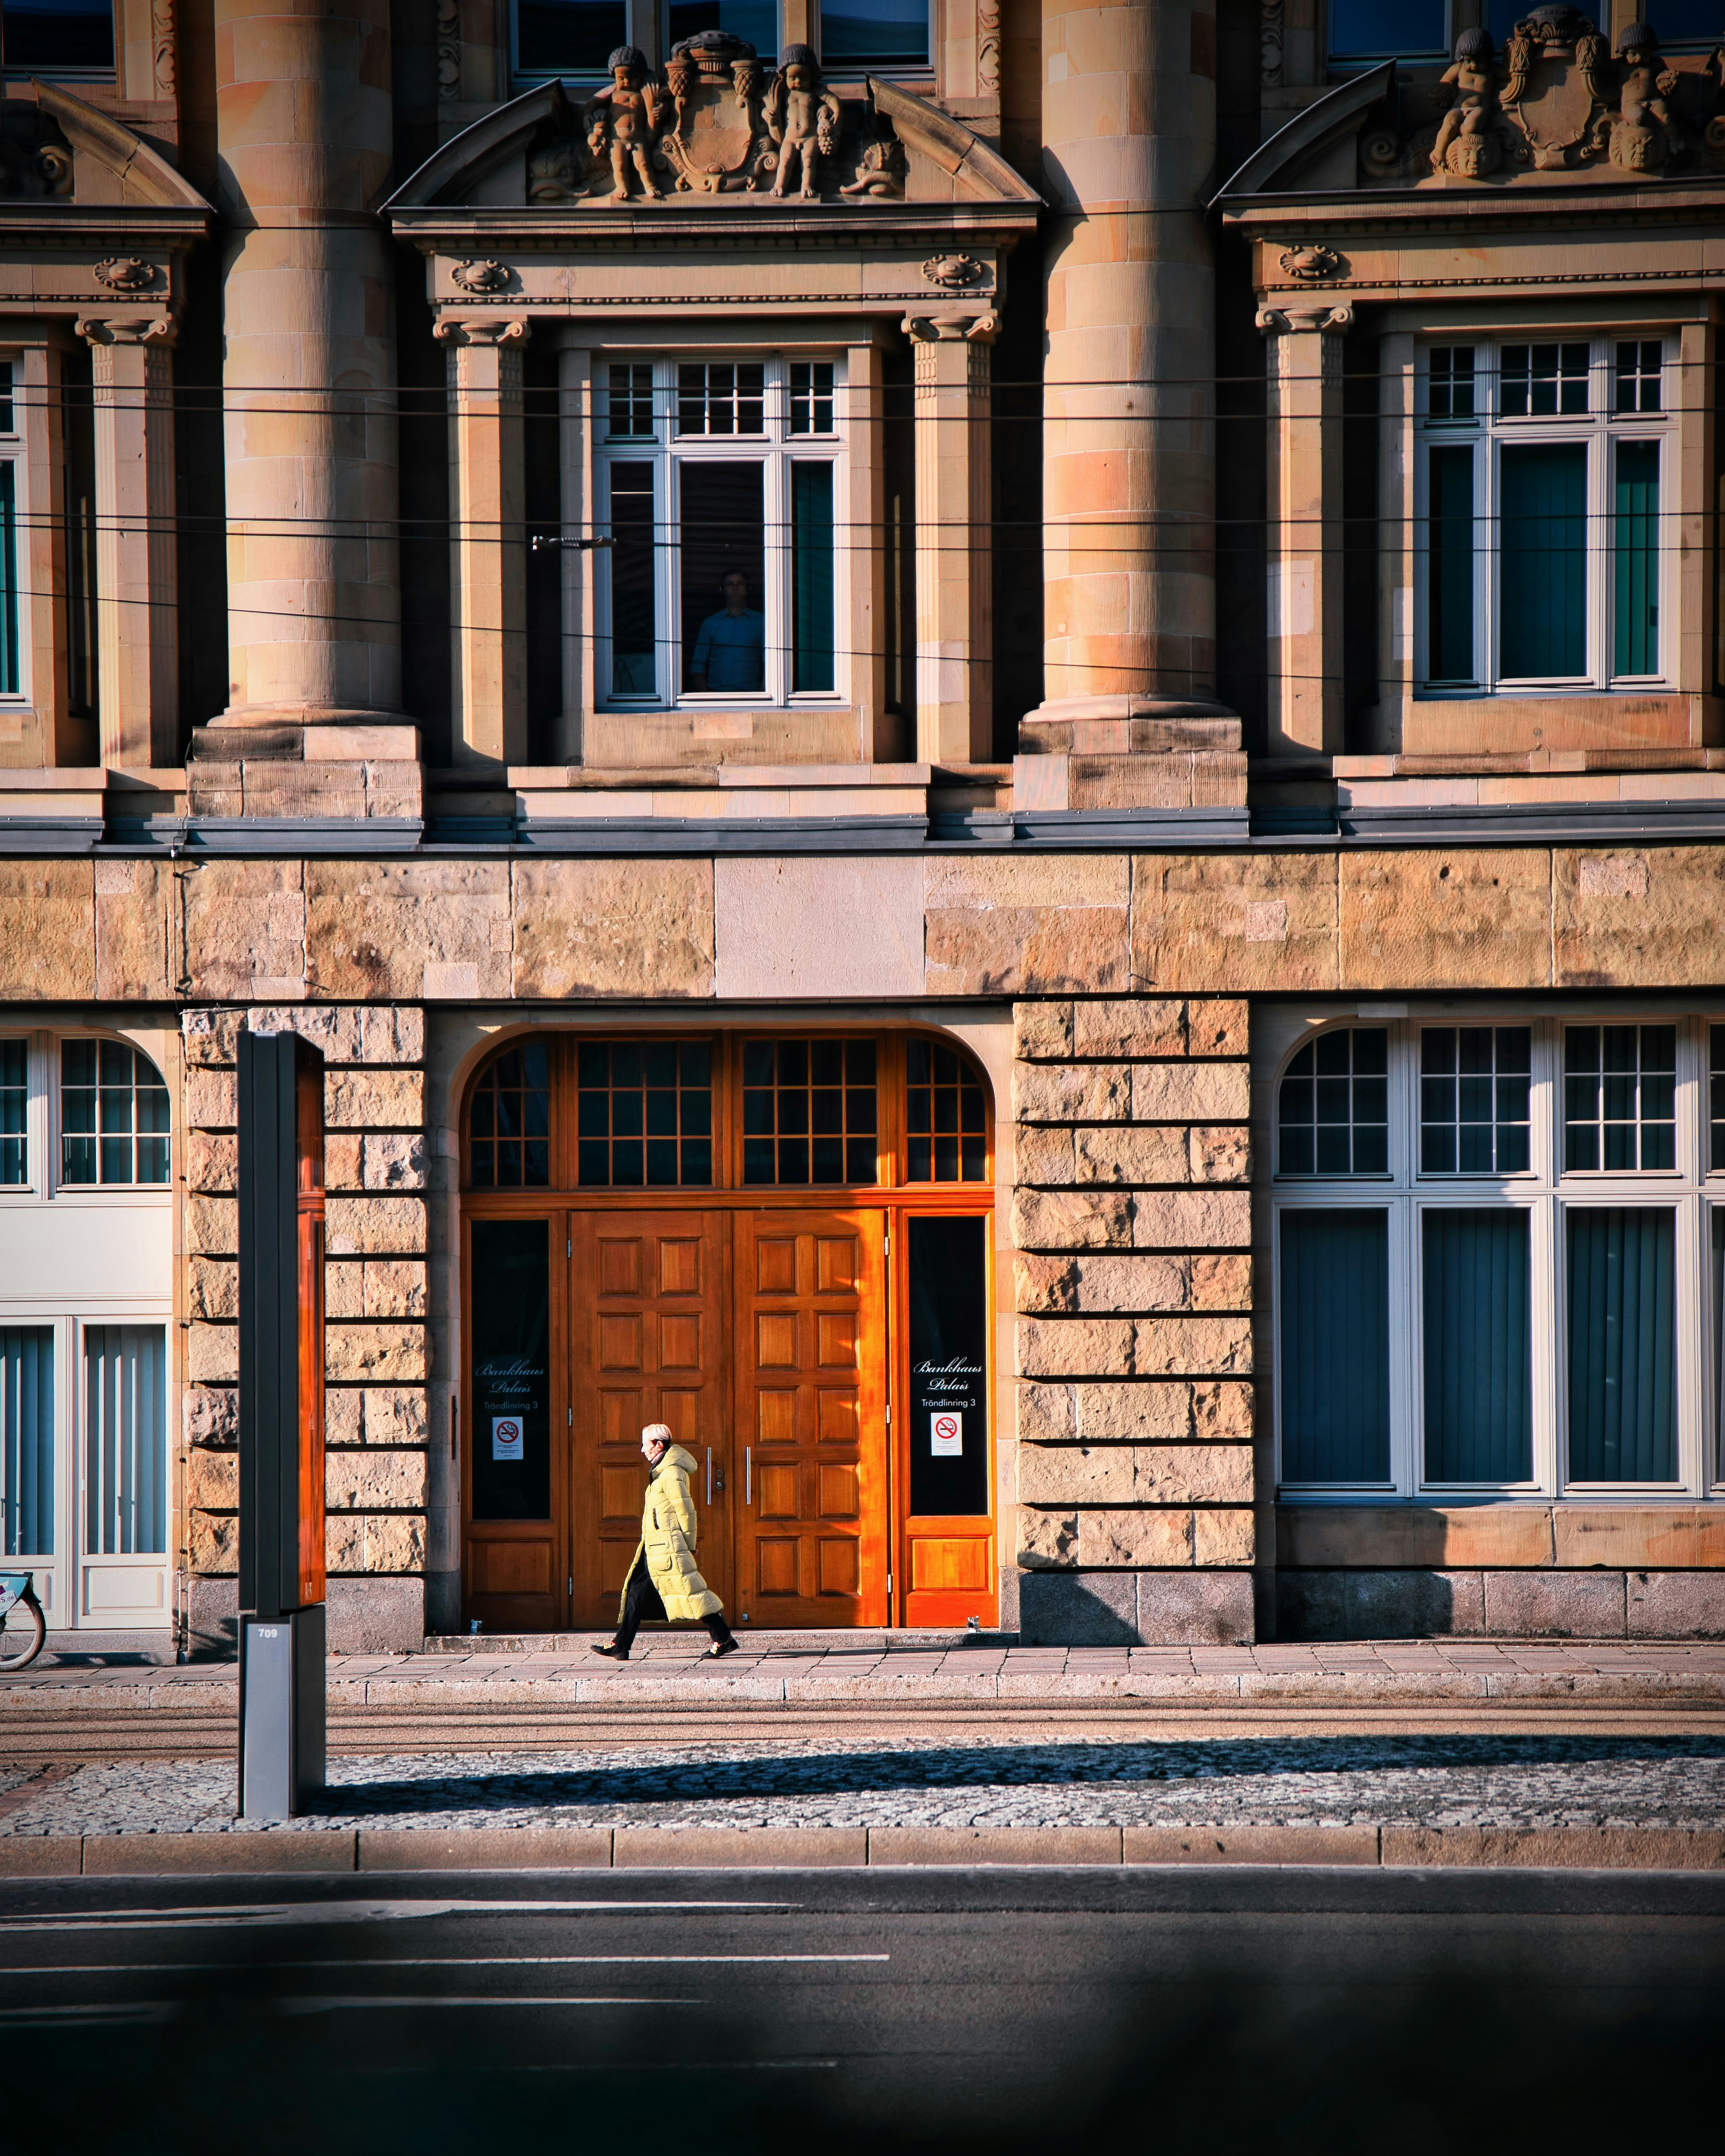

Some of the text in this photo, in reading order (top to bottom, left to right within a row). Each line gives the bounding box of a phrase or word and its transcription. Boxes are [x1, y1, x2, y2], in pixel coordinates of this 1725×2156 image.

[475, 1359, 544, 1376] Bankhaus
[914, 1357, 983, 1373] Bankhaus
[489, 1380, 532, 1393] Palais
[927, 1377, 970, 1390] Palais
[484, 1402, 530, 1410] Tröndlinring
[921, 1399, 968, 1408] Tröndlinring
[258, 1628, 277, 1638] 709
